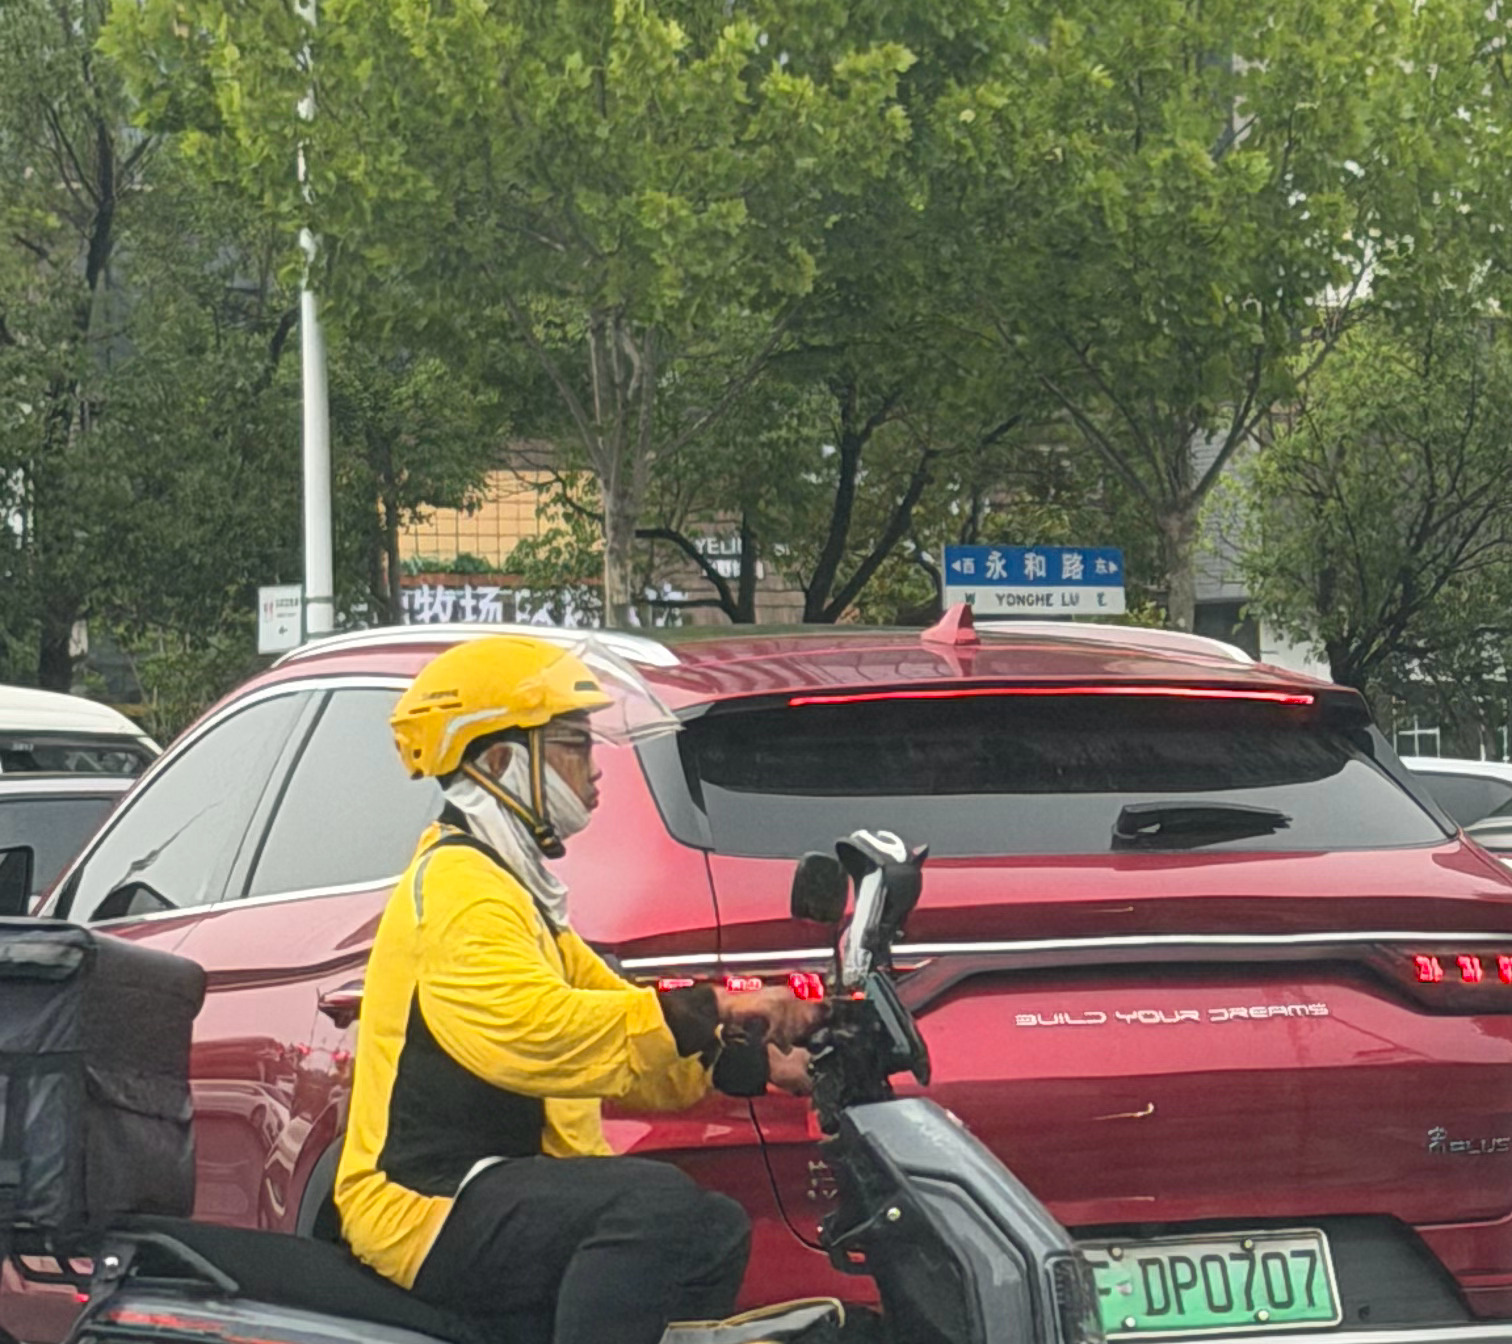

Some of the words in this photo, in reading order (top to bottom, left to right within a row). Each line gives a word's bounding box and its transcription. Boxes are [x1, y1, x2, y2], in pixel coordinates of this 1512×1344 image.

[963, 557, 976, 574] 西
[985, 550, 1085, 581] 永和路
[1095, 557, 1108, 574] 东
[965, 592, 976, 606] W
[995, 591, 1054, 607] YONGHE
[1061, 591, 1080, 607] LU
[1097, 591, 1108, 607] E
[1015, 1010, 1108, 1027] BUILD
[1115, 1009, 1201, 1024] YOUR
[1207, 1002, 1329, 1023] DREAMS
